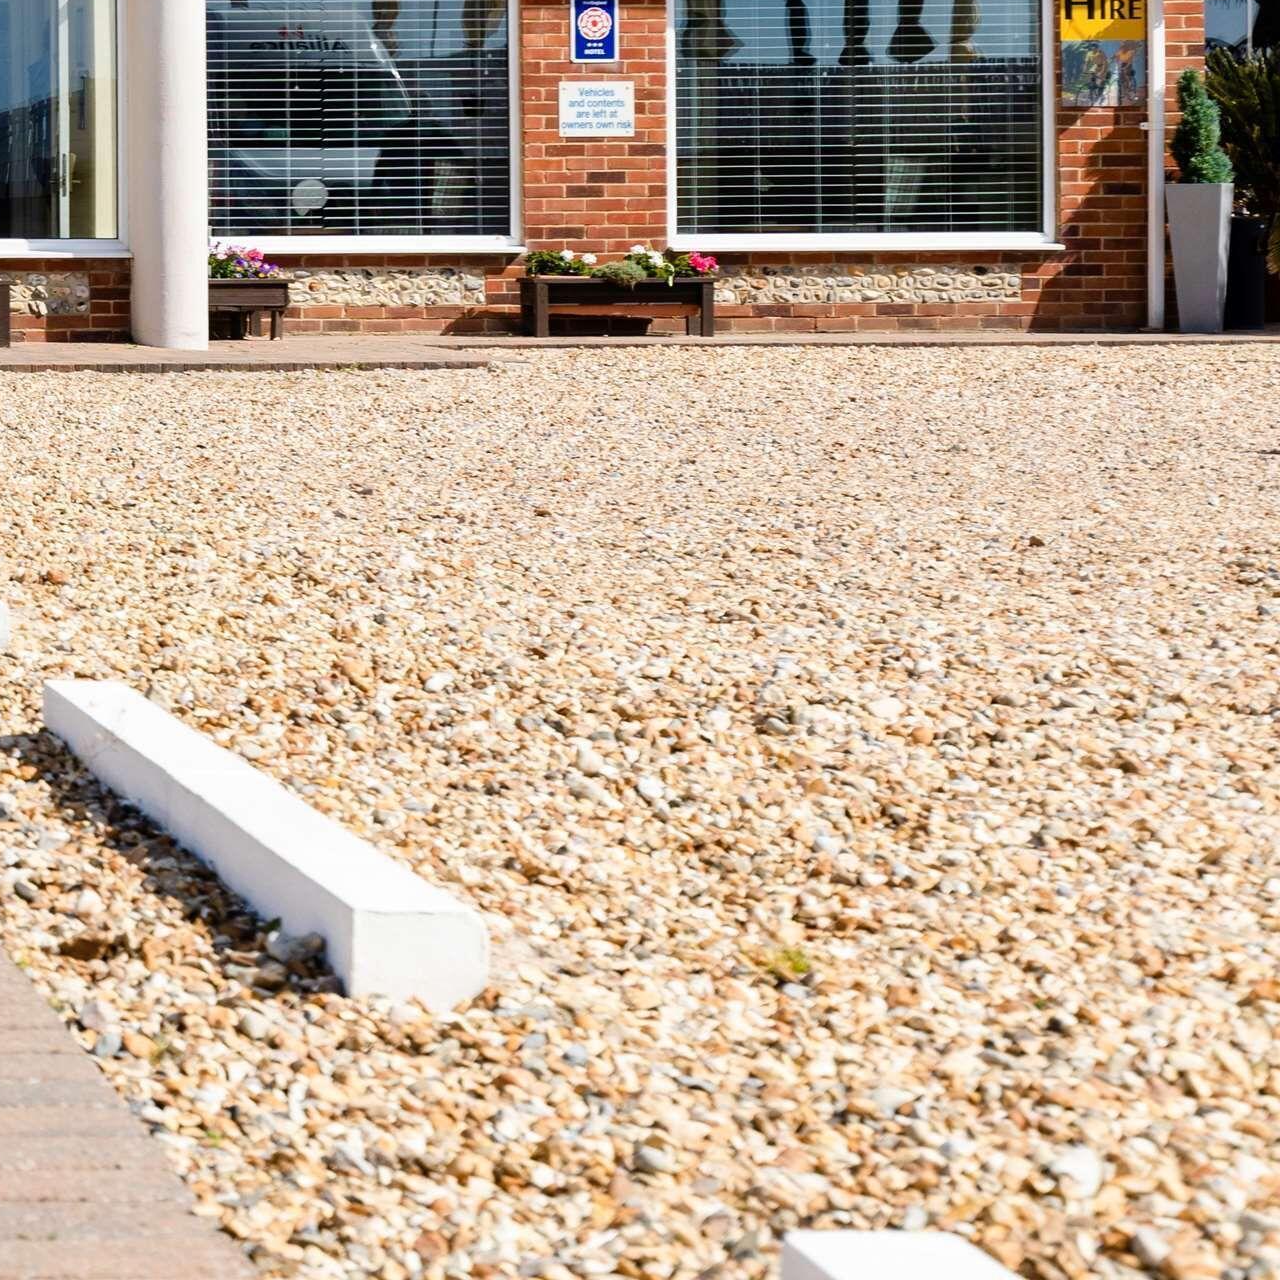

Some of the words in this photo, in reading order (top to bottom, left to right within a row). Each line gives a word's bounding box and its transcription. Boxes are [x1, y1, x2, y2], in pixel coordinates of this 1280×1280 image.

[568, 98, 588, 108] and
[588, 99, 625, 108] contents
[576, 110, 590, 119] are
[592, 109, 607, 119] left
[608, 110, 618, 119] at
[561, 121, 593, 129] owners
[595, 121, 615, 129] own
[616, 119, 633, 129] risk
